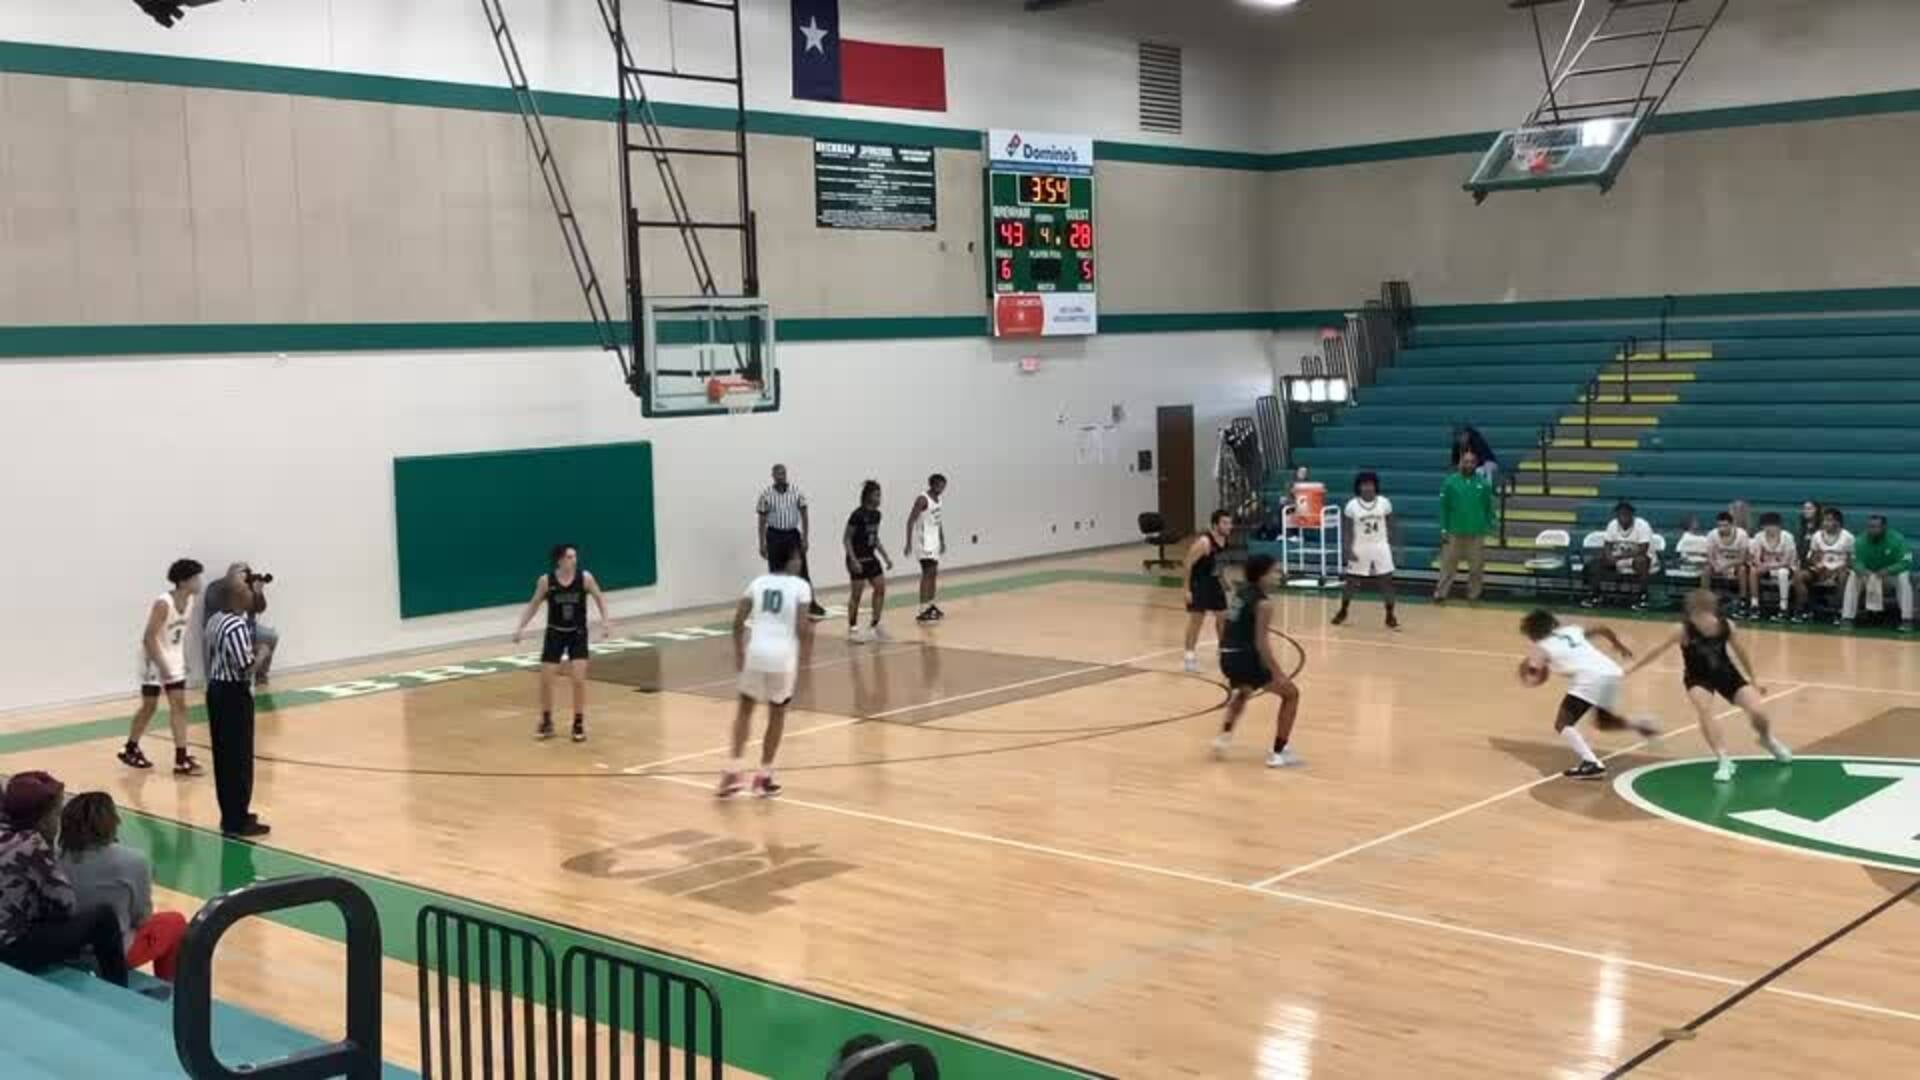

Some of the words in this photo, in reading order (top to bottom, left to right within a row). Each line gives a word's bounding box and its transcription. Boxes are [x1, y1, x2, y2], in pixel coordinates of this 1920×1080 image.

[1023, 143, 1078, 162] Domino's
[1001, 222, 1024, 248] 43
[1069, 223, 1091, 248] 28
[1001, 260, 1012, 280] 6
[1082, 261, 1091, 280] 5
[1364, 522, 1378, 534] 24
[762, 589, 783, 614] 10
